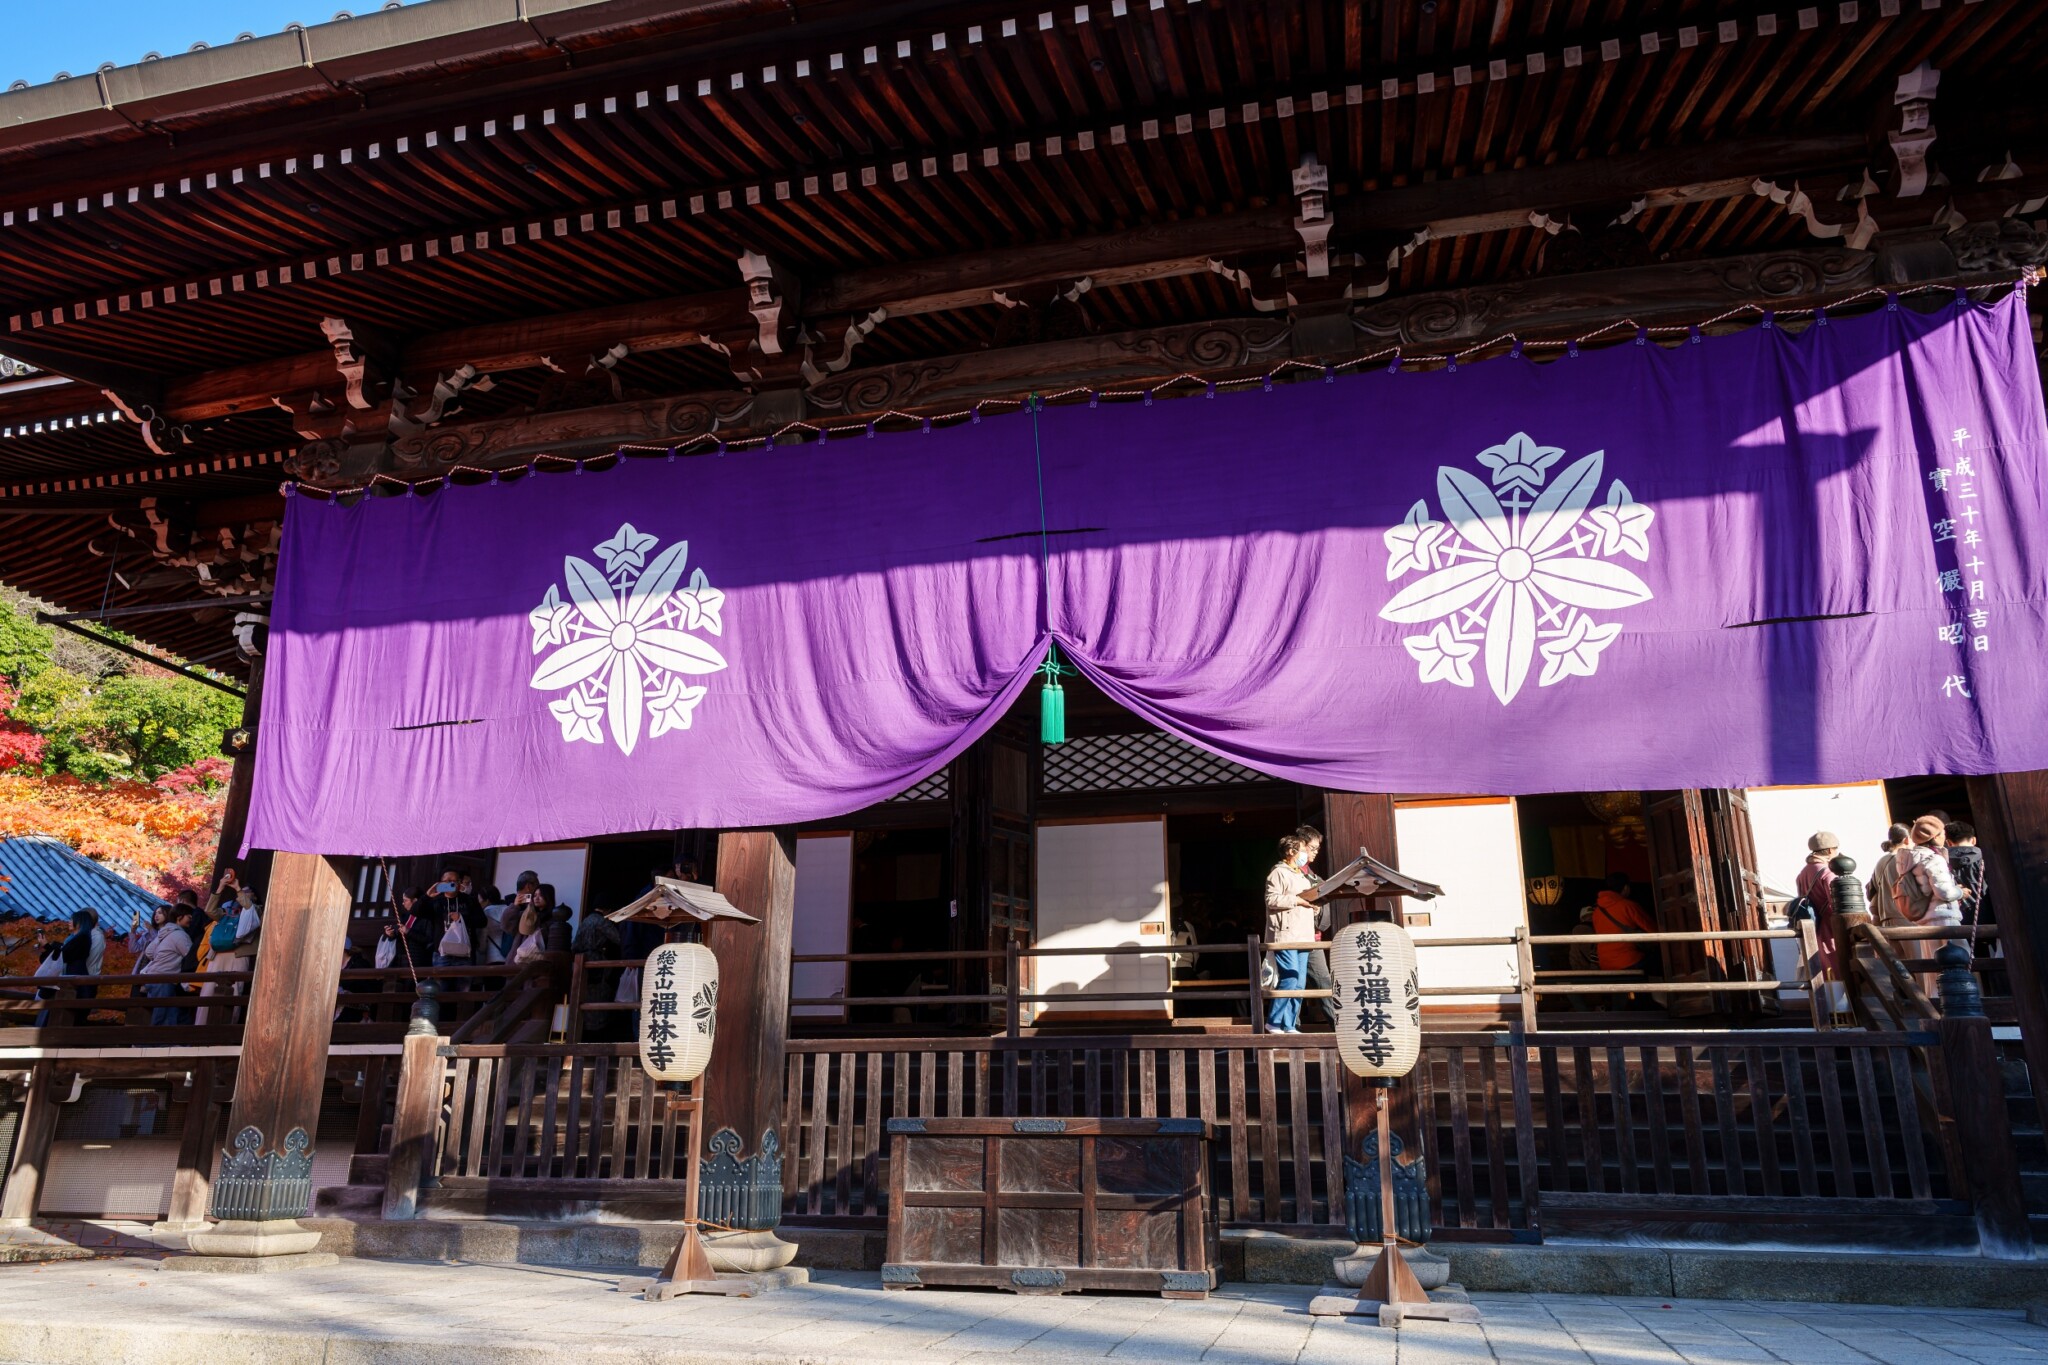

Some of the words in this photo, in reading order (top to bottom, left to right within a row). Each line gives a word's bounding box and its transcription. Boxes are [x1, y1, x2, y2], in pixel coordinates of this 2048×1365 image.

[1951, 428, 1989, 652] 平成三十年十月吉日
